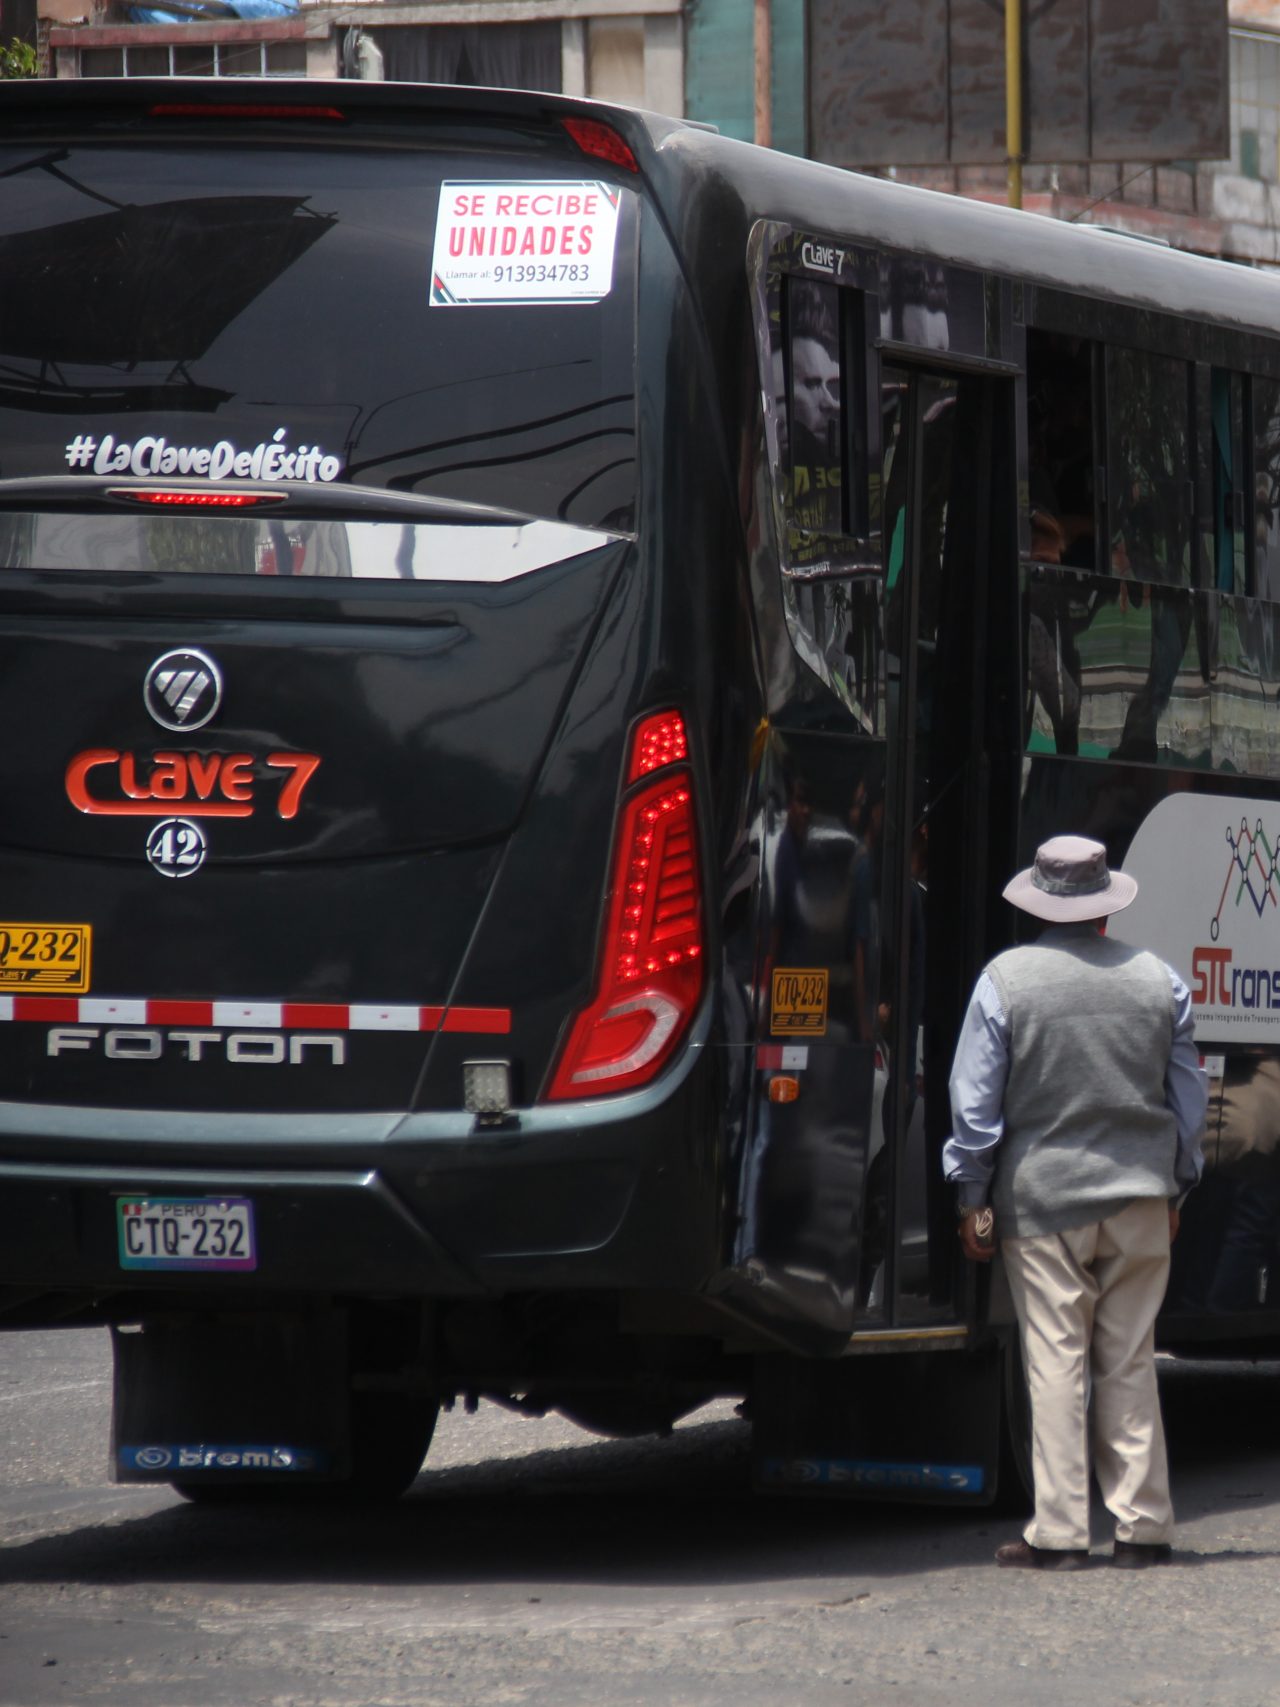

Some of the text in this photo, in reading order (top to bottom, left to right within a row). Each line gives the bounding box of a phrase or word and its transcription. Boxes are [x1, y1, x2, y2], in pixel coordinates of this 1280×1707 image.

[453, 194, 598, 216] SE RECIBE
[449, 225, 593, 257] UNIDADES
[446, 270, 479, 280] Llamar
[494, 264, 589, 282] 913934783
[835, 249, 845, 275] 7
[64, 427, 340, 484] #LaClaveDelÉxito
[266, 753, 321, 819] 7
[151, 829, 199, 865] 42
[776, 976, 824, 1011] CTQ-232
[47, 1027, 344, 1065] FOTON
[126, 1217, 246, 1257] CTQ-232
